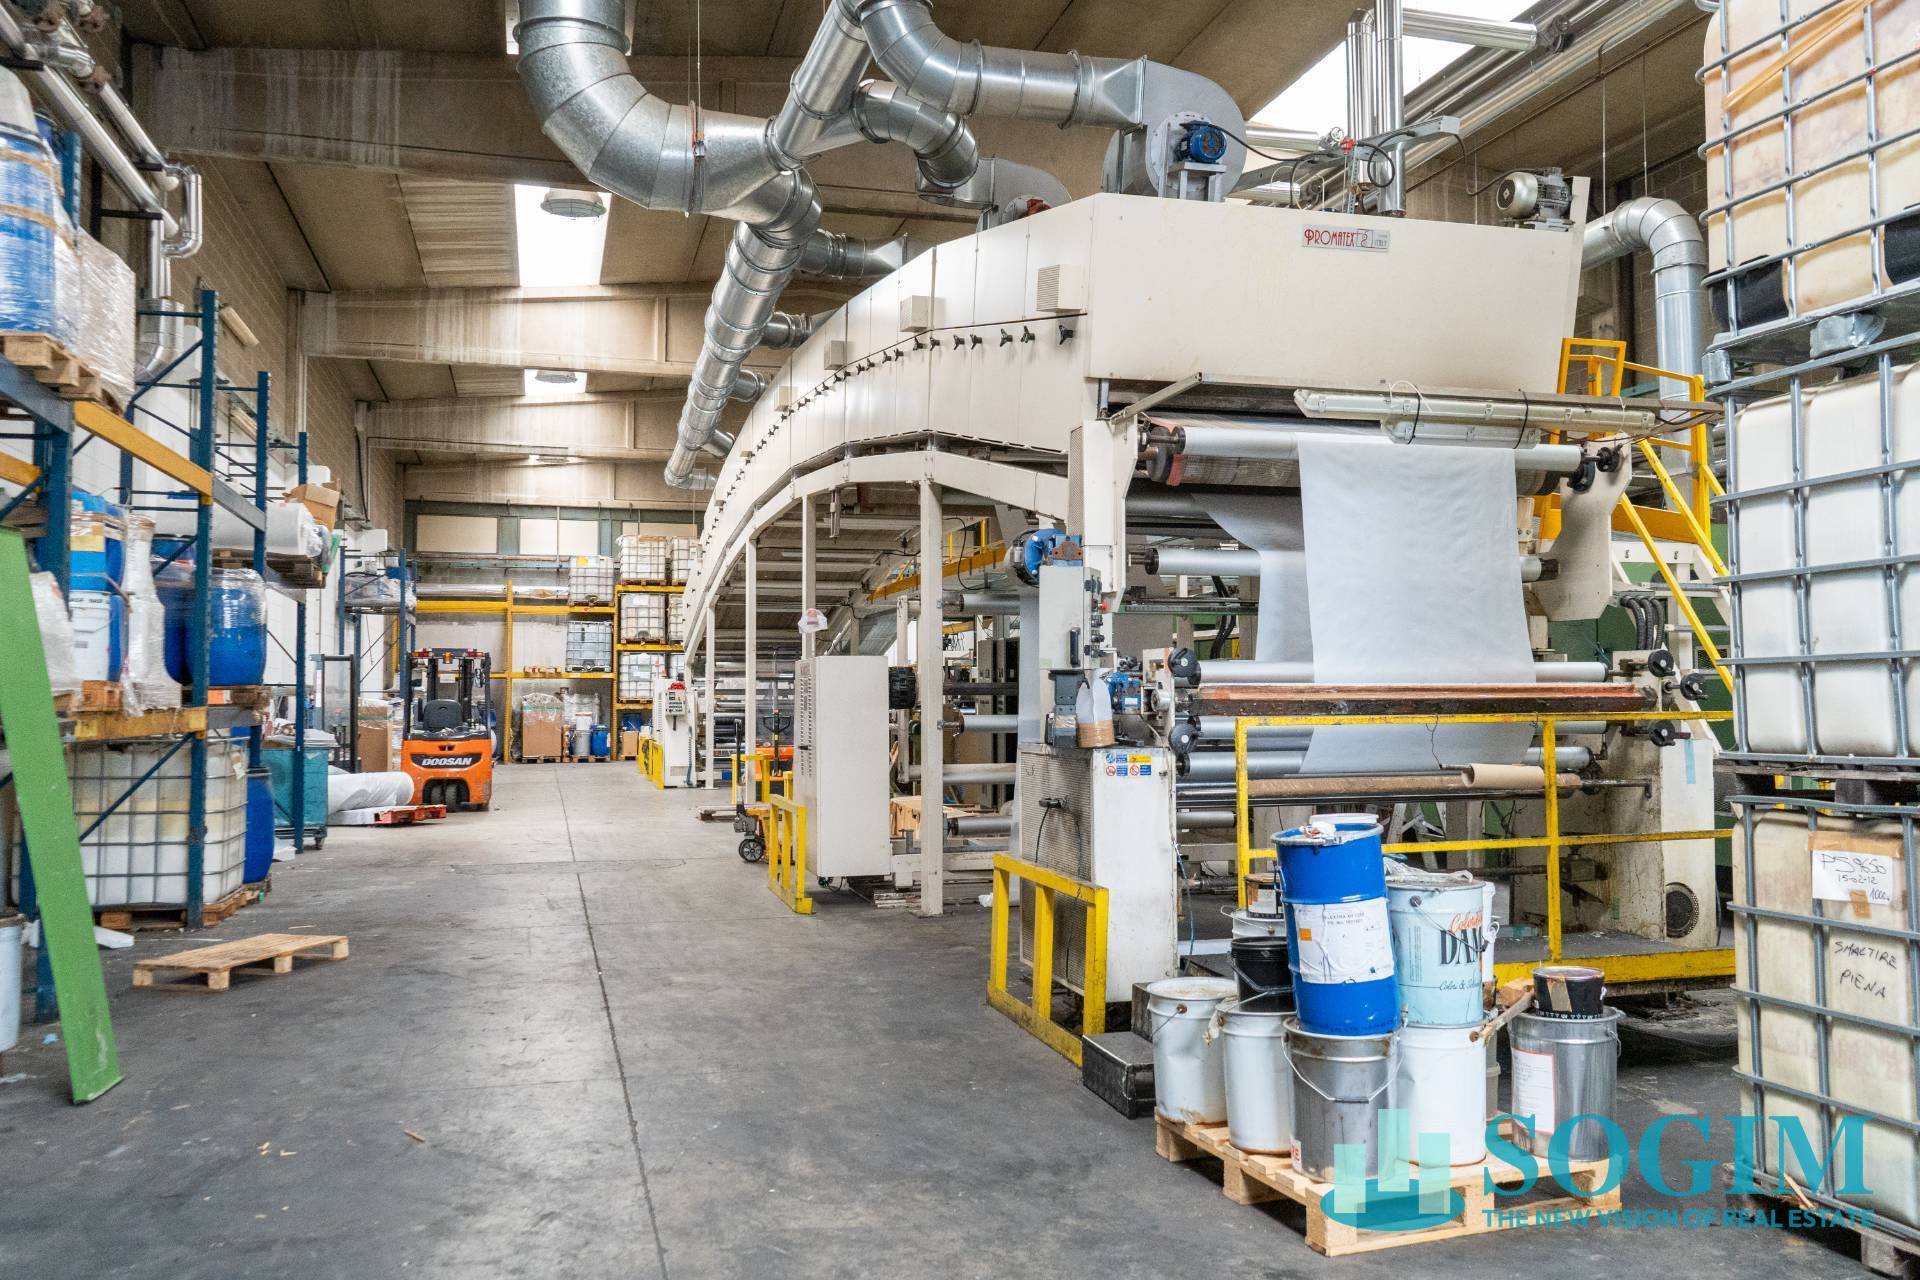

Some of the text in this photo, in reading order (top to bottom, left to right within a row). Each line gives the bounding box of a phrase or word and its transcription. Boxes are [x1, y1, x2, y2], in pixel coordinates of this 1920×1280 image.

[1304, 228, 1356, 247] PROMATEX
[422, 757, 472, 766] DOOSAN
[1839, 969, 1887, 999] PIENA
